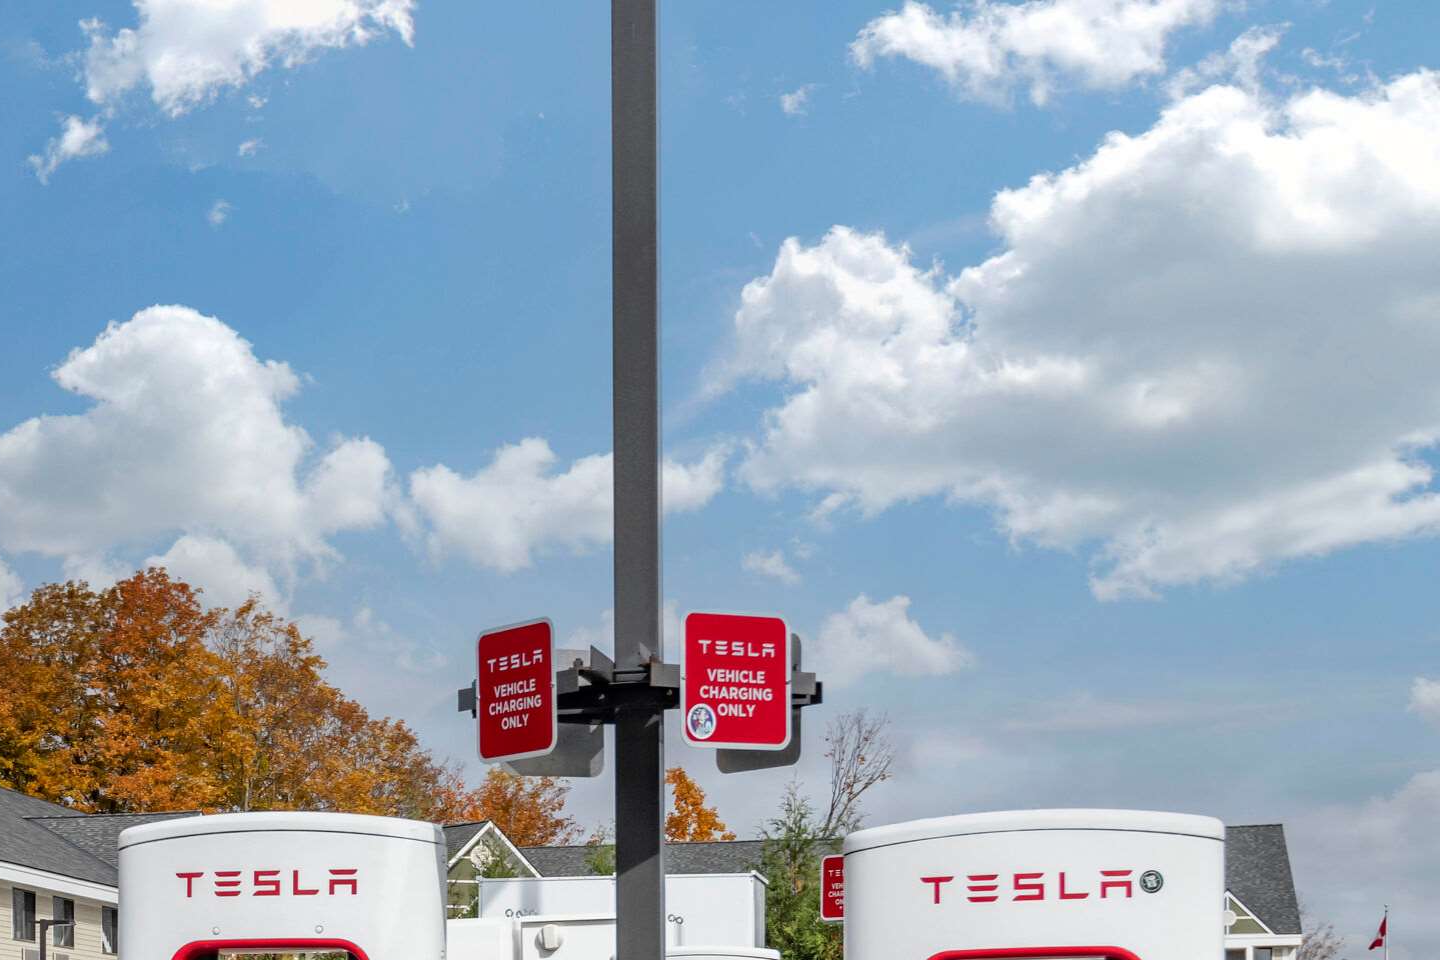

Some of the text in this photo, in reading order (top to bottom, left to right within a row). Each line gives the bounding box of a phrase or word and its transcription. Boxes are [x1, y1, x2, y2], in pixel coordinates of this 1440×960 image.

[697, 639, 775, 659] TESLA
[487, 648, 543, 673] TESLA
[706, 668, 766, 684] VEHICLE
[493, 678, 536, 698] VEHICLE
[699, 685, 773, 702] CHARGING
[488, 694, 542, 716] CHARGING
[717, 703, 756, 718] ONLY
[501, 713, 529, 730] ONLY
[176, 868, 358, 898] TESLA
[920, 869, 1133, 905] TESLA
